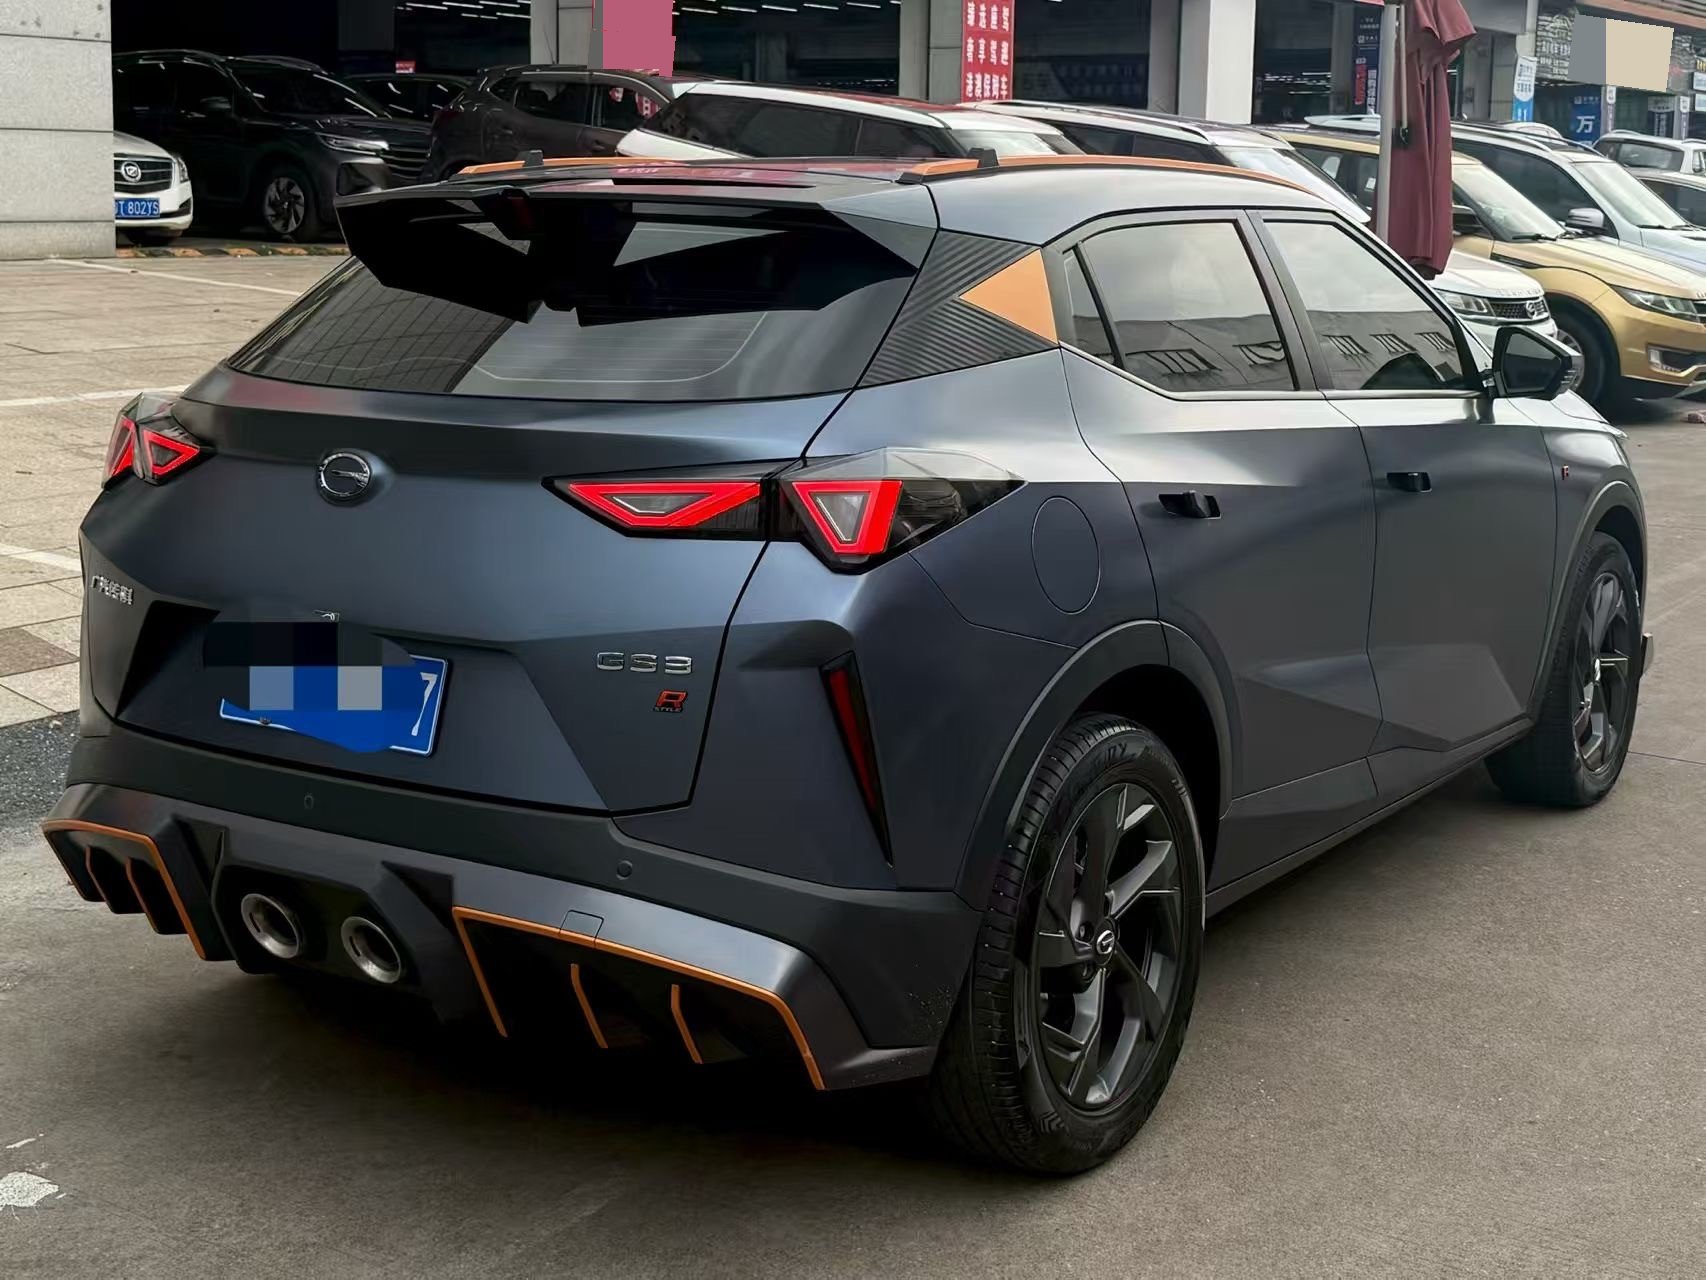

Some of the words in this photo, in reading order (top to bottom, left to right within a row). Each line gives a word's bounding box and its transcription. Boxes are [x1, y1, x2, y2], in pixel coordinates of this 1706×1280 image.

[1576, 115, 1595, 133] 万
[597, 652, 692, 675] GS3
[656, 690, 687, 707] R
